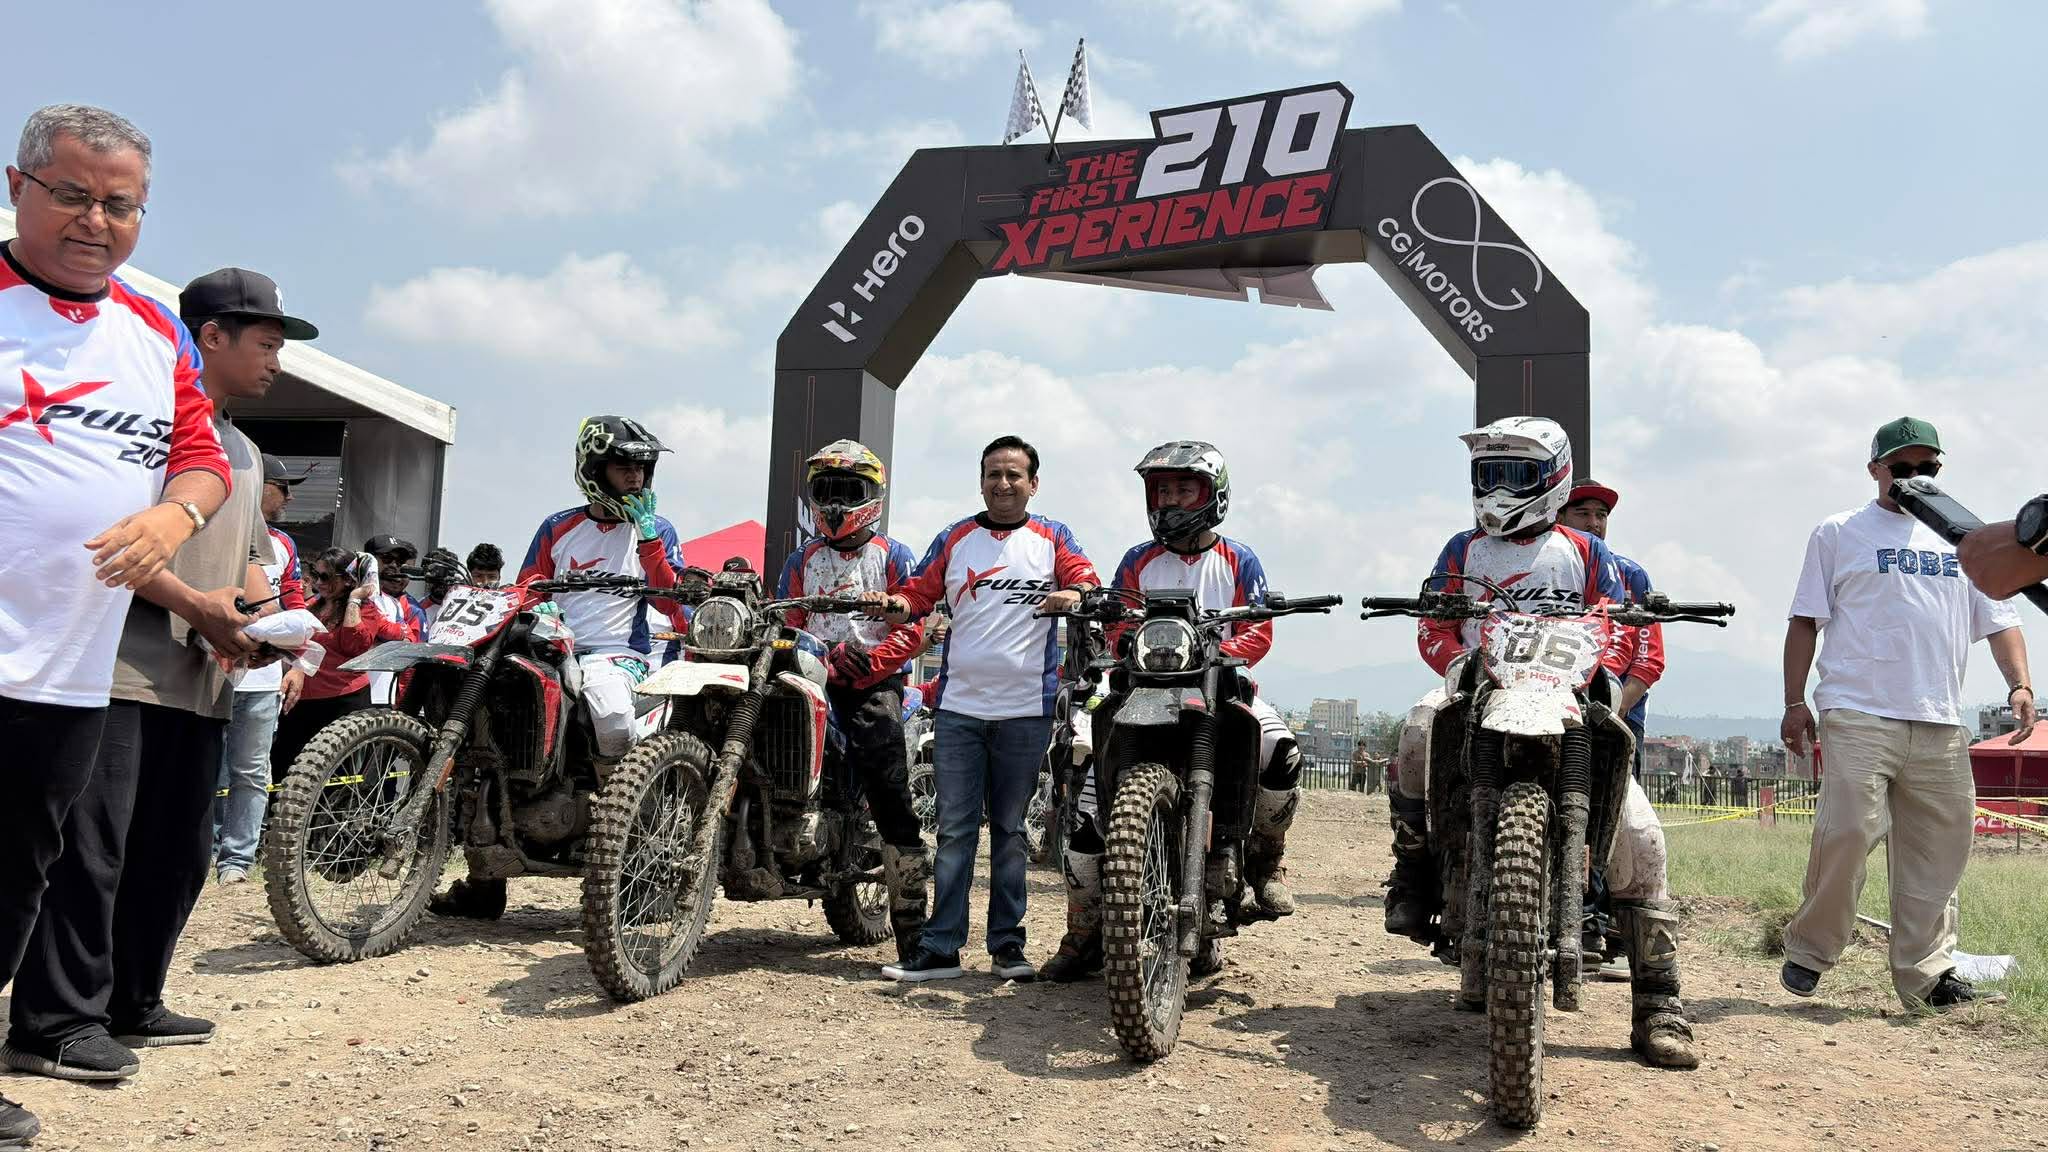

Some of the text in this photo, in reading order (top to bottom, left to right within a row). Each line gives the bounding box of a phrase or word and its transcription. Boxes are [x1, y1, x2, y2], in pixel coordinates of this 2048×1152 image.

[1136, 88, 1347, 199] 210
[1065, 150, 1140, 183] THE
[1029, 176, 1137, 216] FIRST
[993, 172, 1334, 270] XPERIENCE
[852, 214, 926, 303] Hero
[0, 368, 173, 446] XPULS
[955, 566, 1053, 608] XPULSE
[1003, 593, 1047, 605] 210
[1503, 631, 1581, 671] 06
[1530, 671, 1561, 686] Hero
